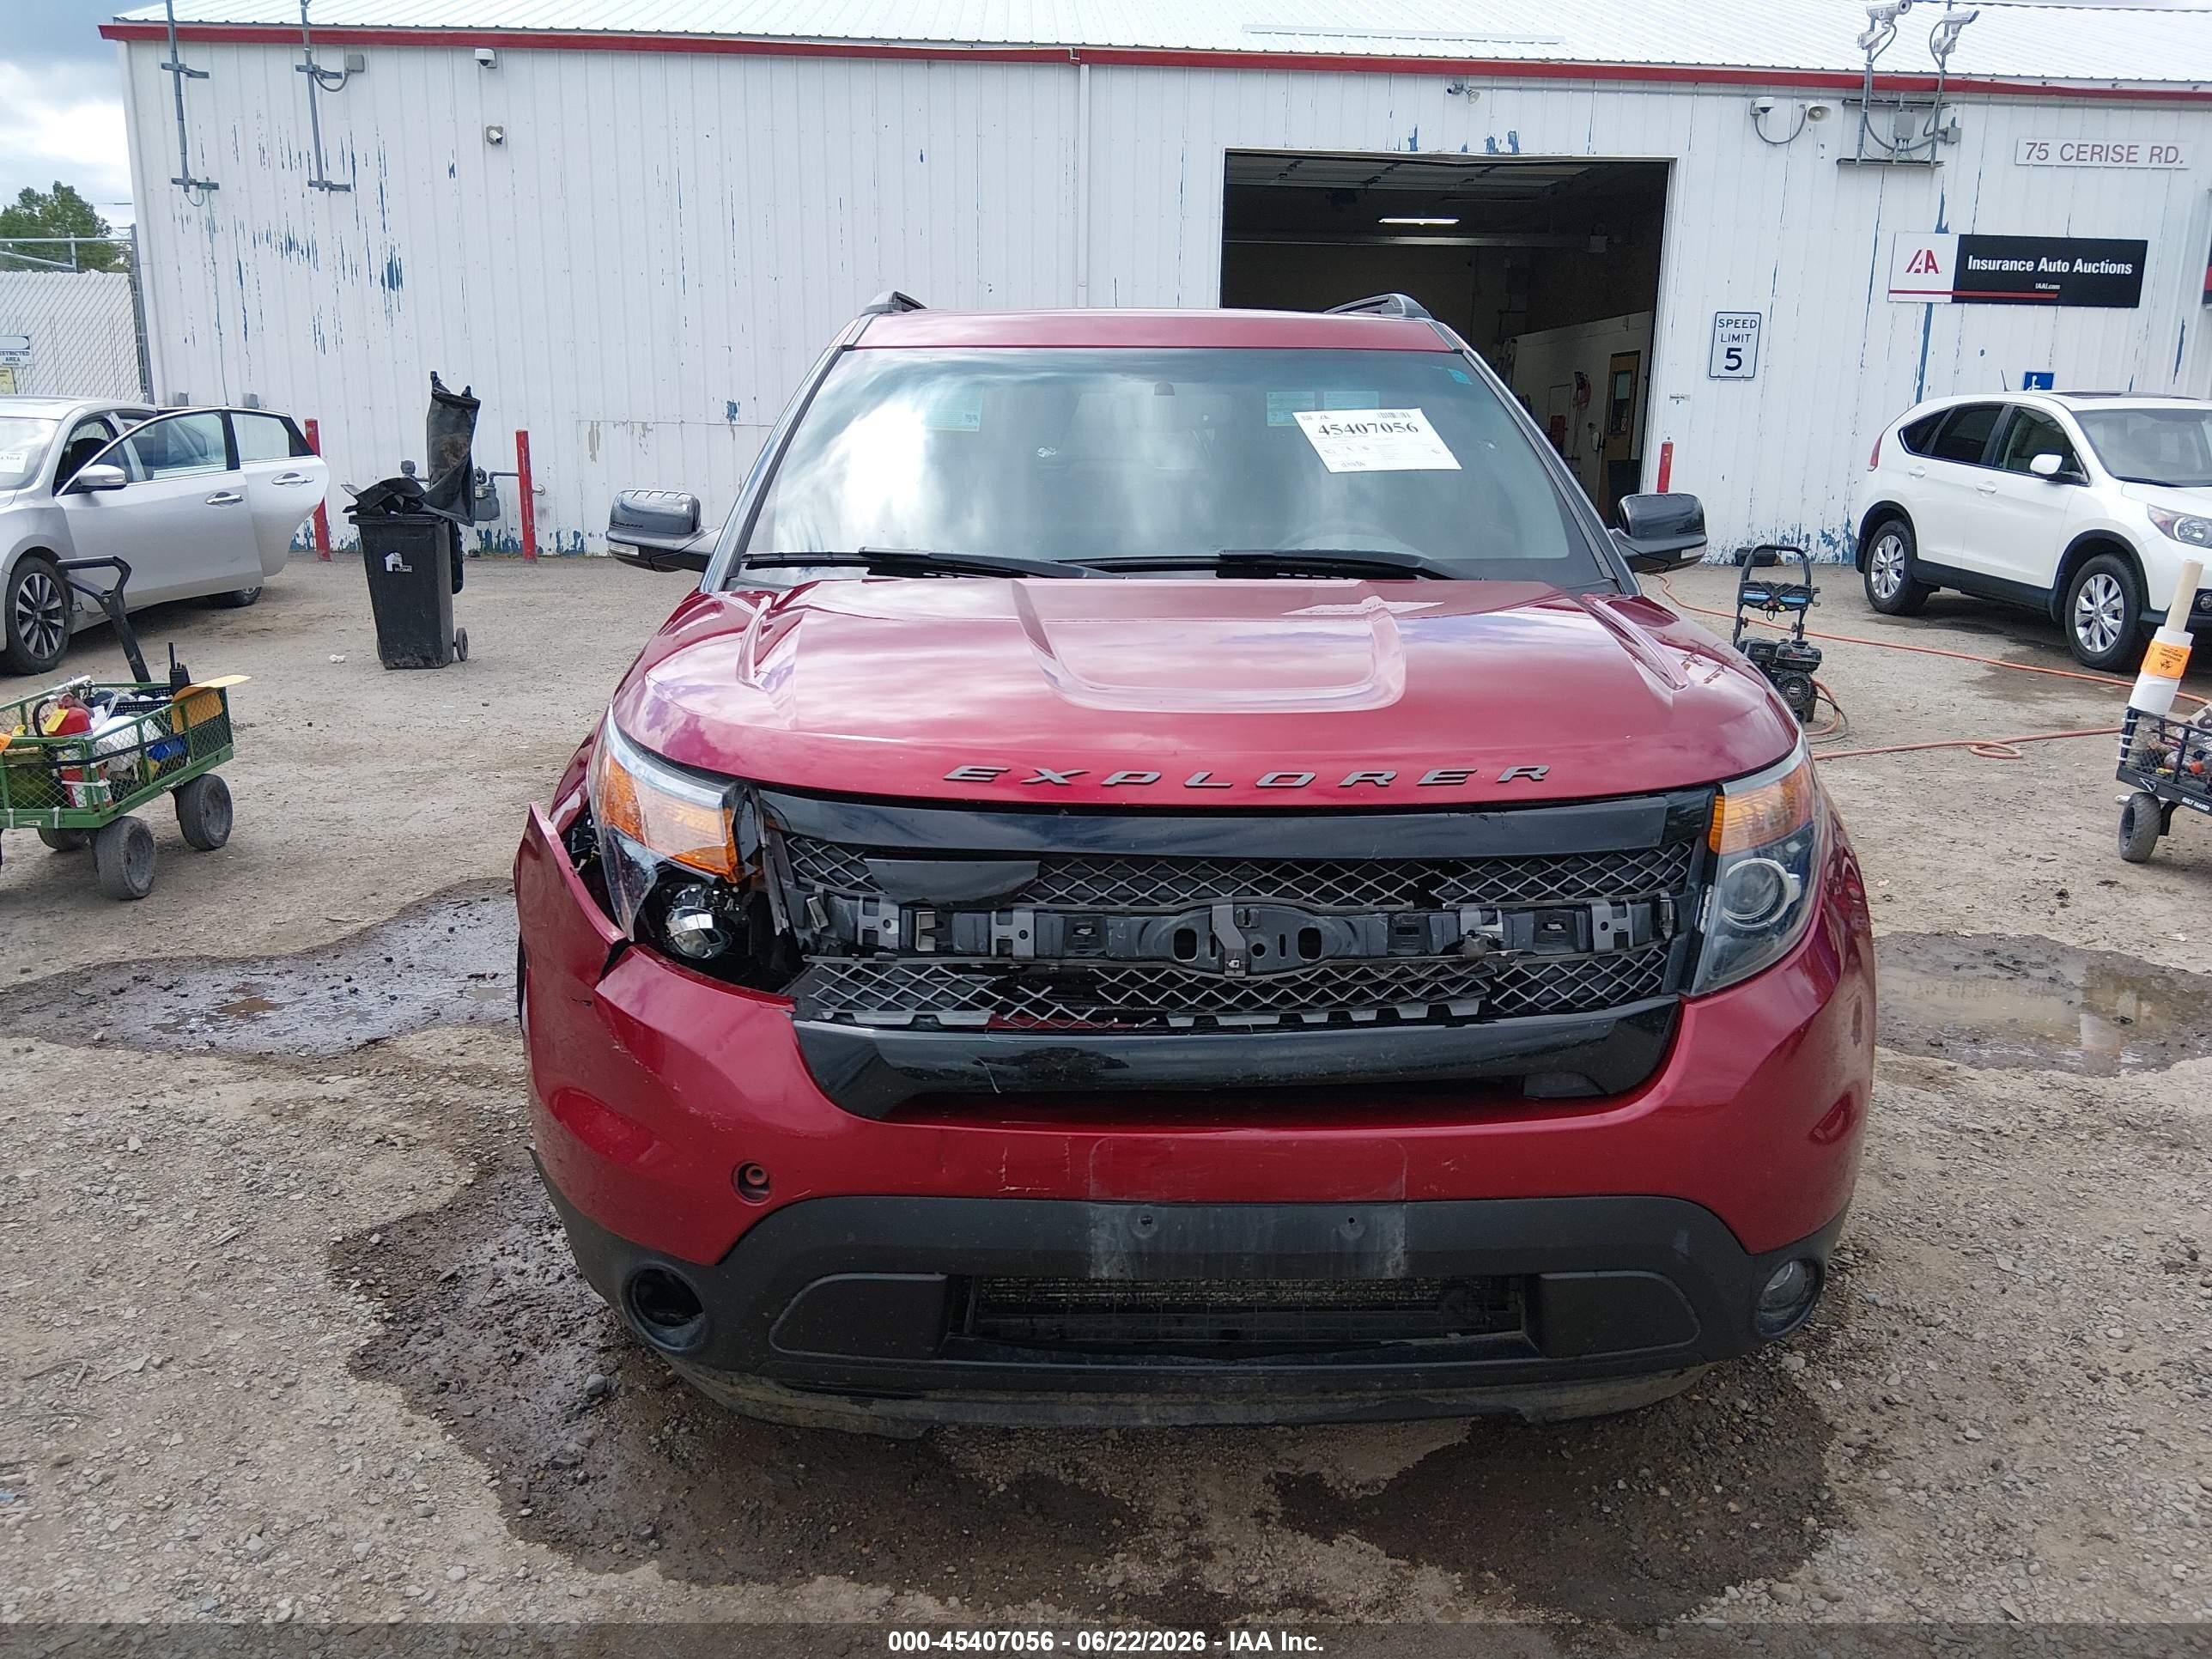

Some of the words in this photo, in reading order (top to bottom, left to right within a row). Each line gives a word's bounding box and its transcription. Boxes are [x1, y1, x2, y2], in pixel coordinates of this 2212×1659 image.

[2026, 142, 2050, 161] 75
[2060, 143, 2140, 163] CERISE
[2148, 145, 2184, 164] RD.
[1967, 255, 2034, 272] Insurance
[2037, 257, 2070, 273] Auto
[2073, 258, 2133, 275] Auctions
[1717, 319, 1758, 329] SPEED
[1721, 332, 1752, 343] LIMIT
[1724, 347, 1742, 372] 5
[1318, 422, 1419, 435] 45407056
[943, 763, 1551, 788] EXPLORER
